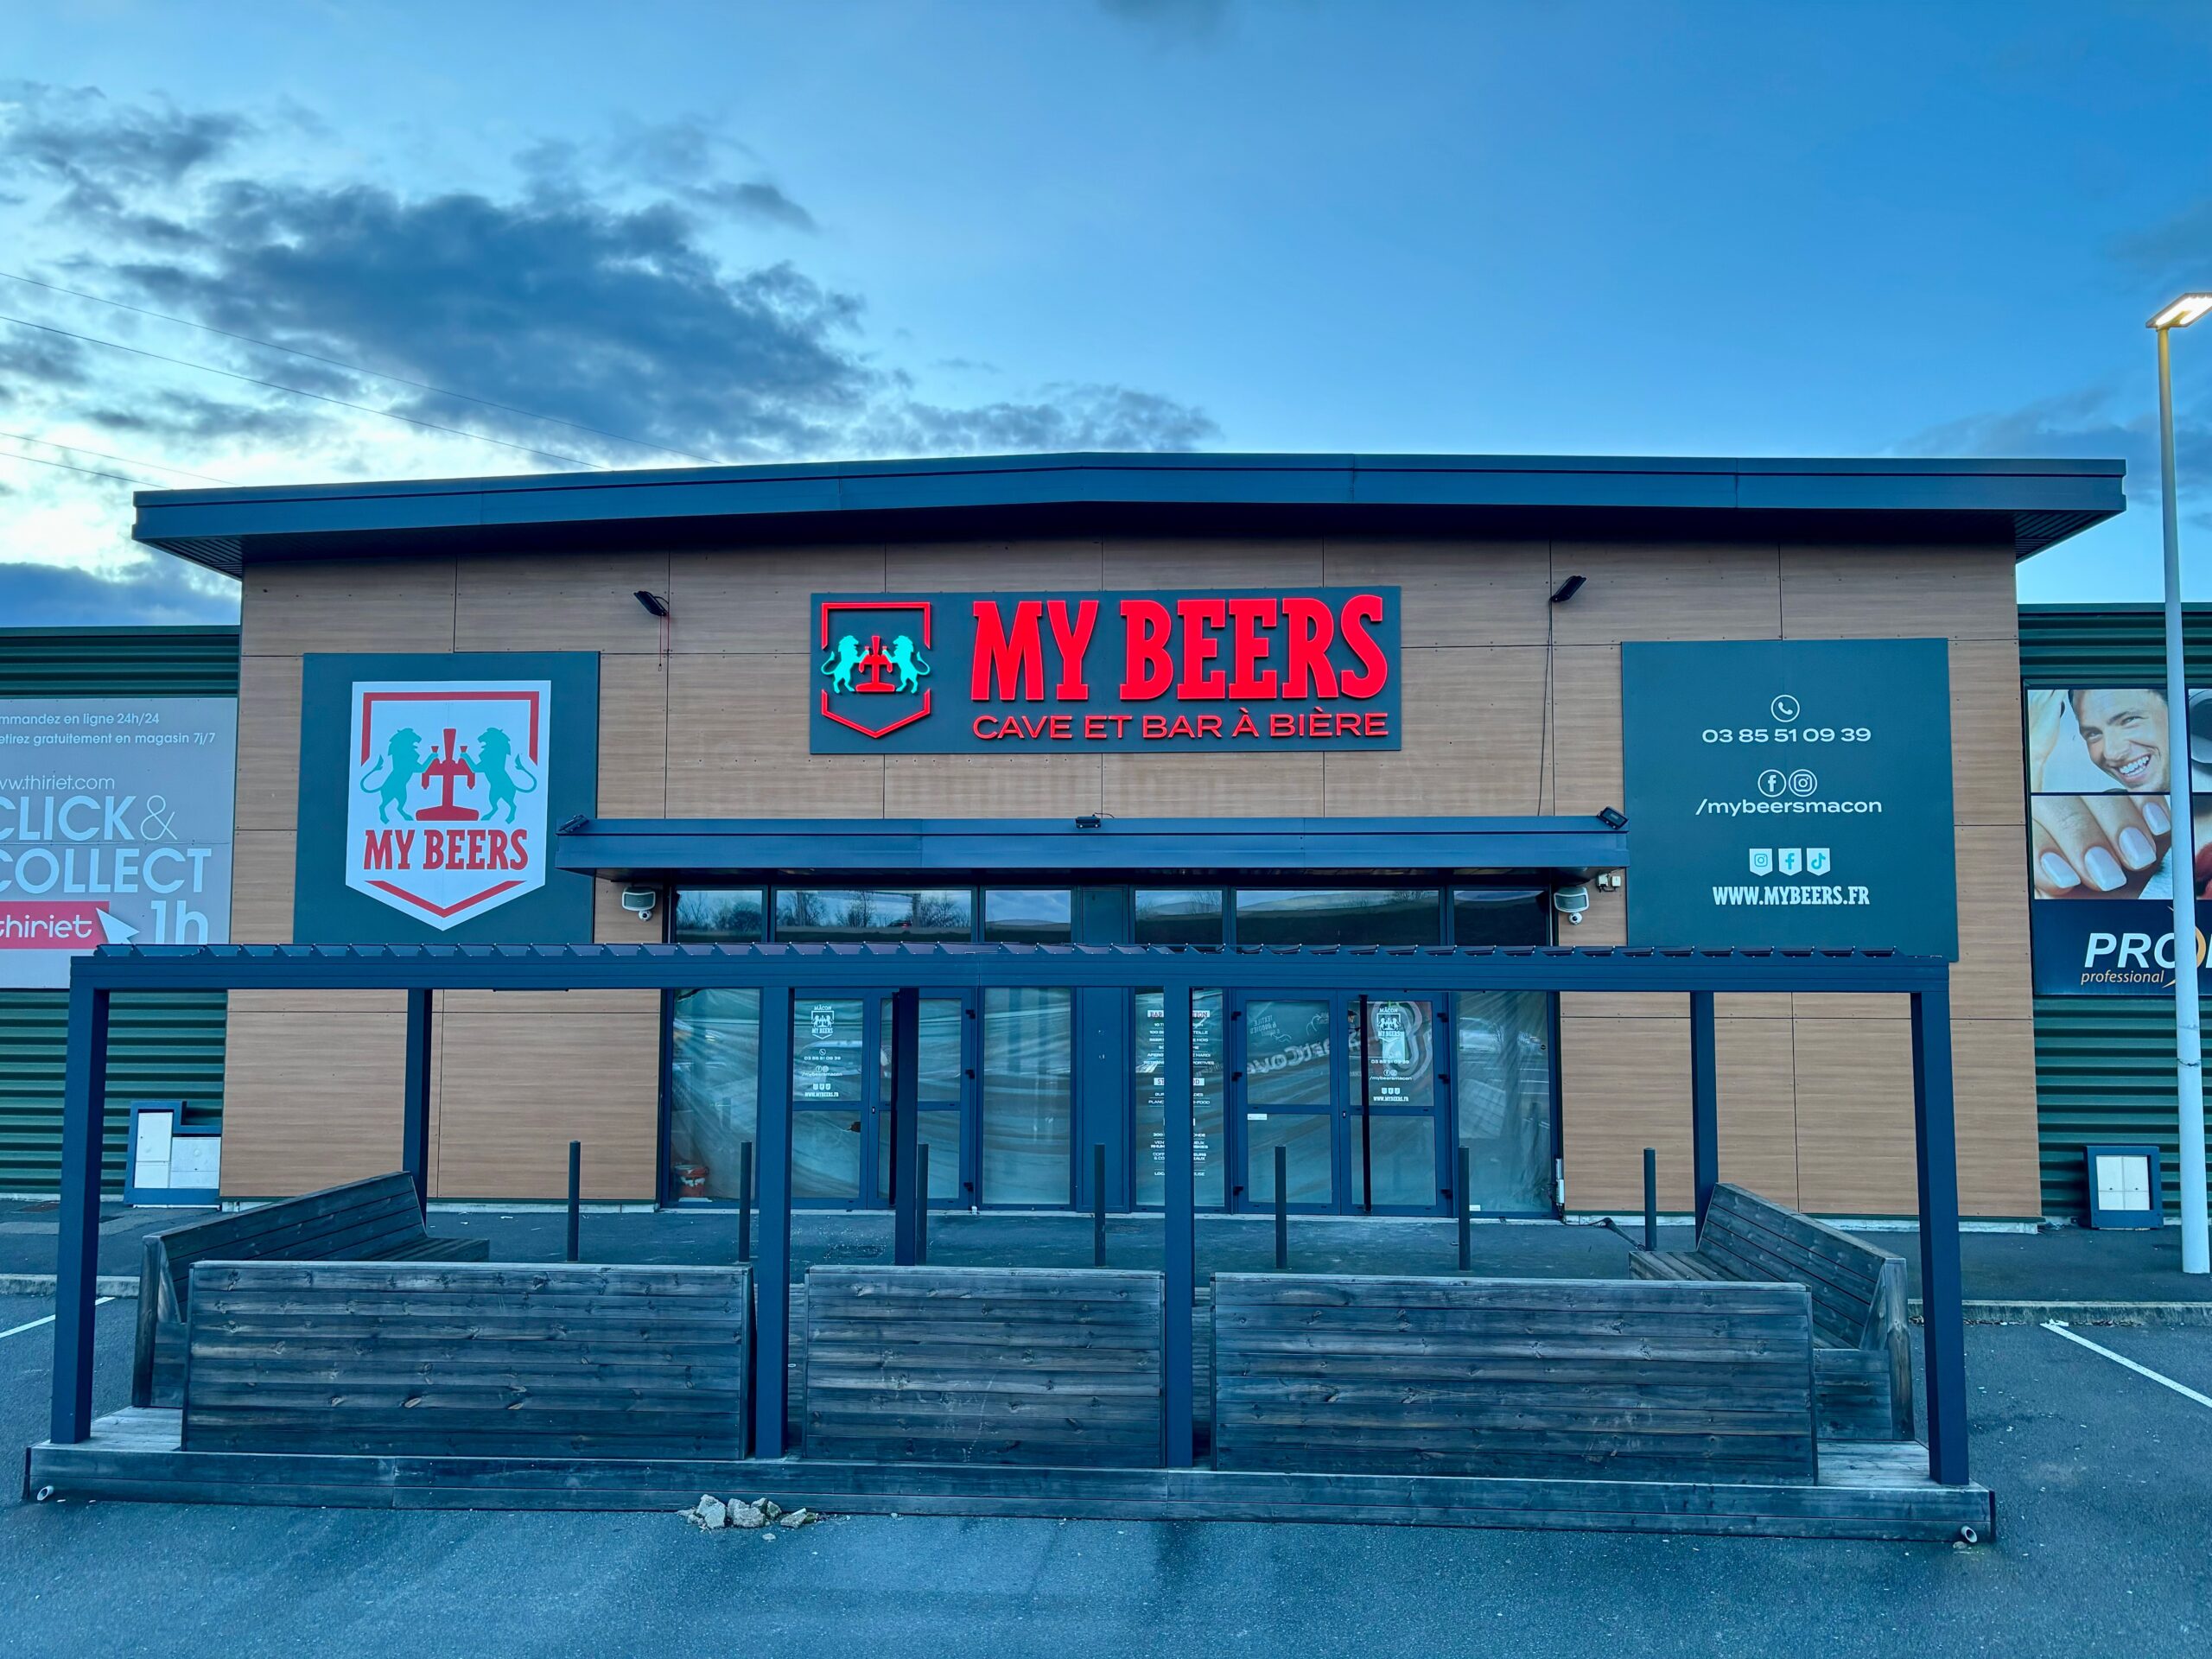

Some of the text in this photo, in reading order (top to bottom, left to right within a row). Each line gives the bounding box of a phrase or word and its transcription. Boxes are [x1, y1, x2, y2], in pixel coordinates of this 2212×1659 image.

[971, 594, 1389, 701] MY BEERS
[64, 715, 81, 725] en
[83, 713, 114, 728] ligne
[117, 713, 160, 726] 24h/24
[973, 706, 1389, 740] CAVE ET BAR À BIÈRE
[34, 733, 111, 747] gratuitement
[115, 734, 131, 745] en
[135, 733, 189, 747] magasin
[193, 733, 216, 746] 7j/7
[1701, 728, 1872, 743] 03 85 51 09 39
[1695, 798, 1882, 817] /mybeersmacon
[140, 794, 178, 841] &
[363, 829, 529, 871] MY BEERS
[1713, 886, 1870, 906] WWW.MYBEERS.FR
[2081, 969, 2164, 986] professional
